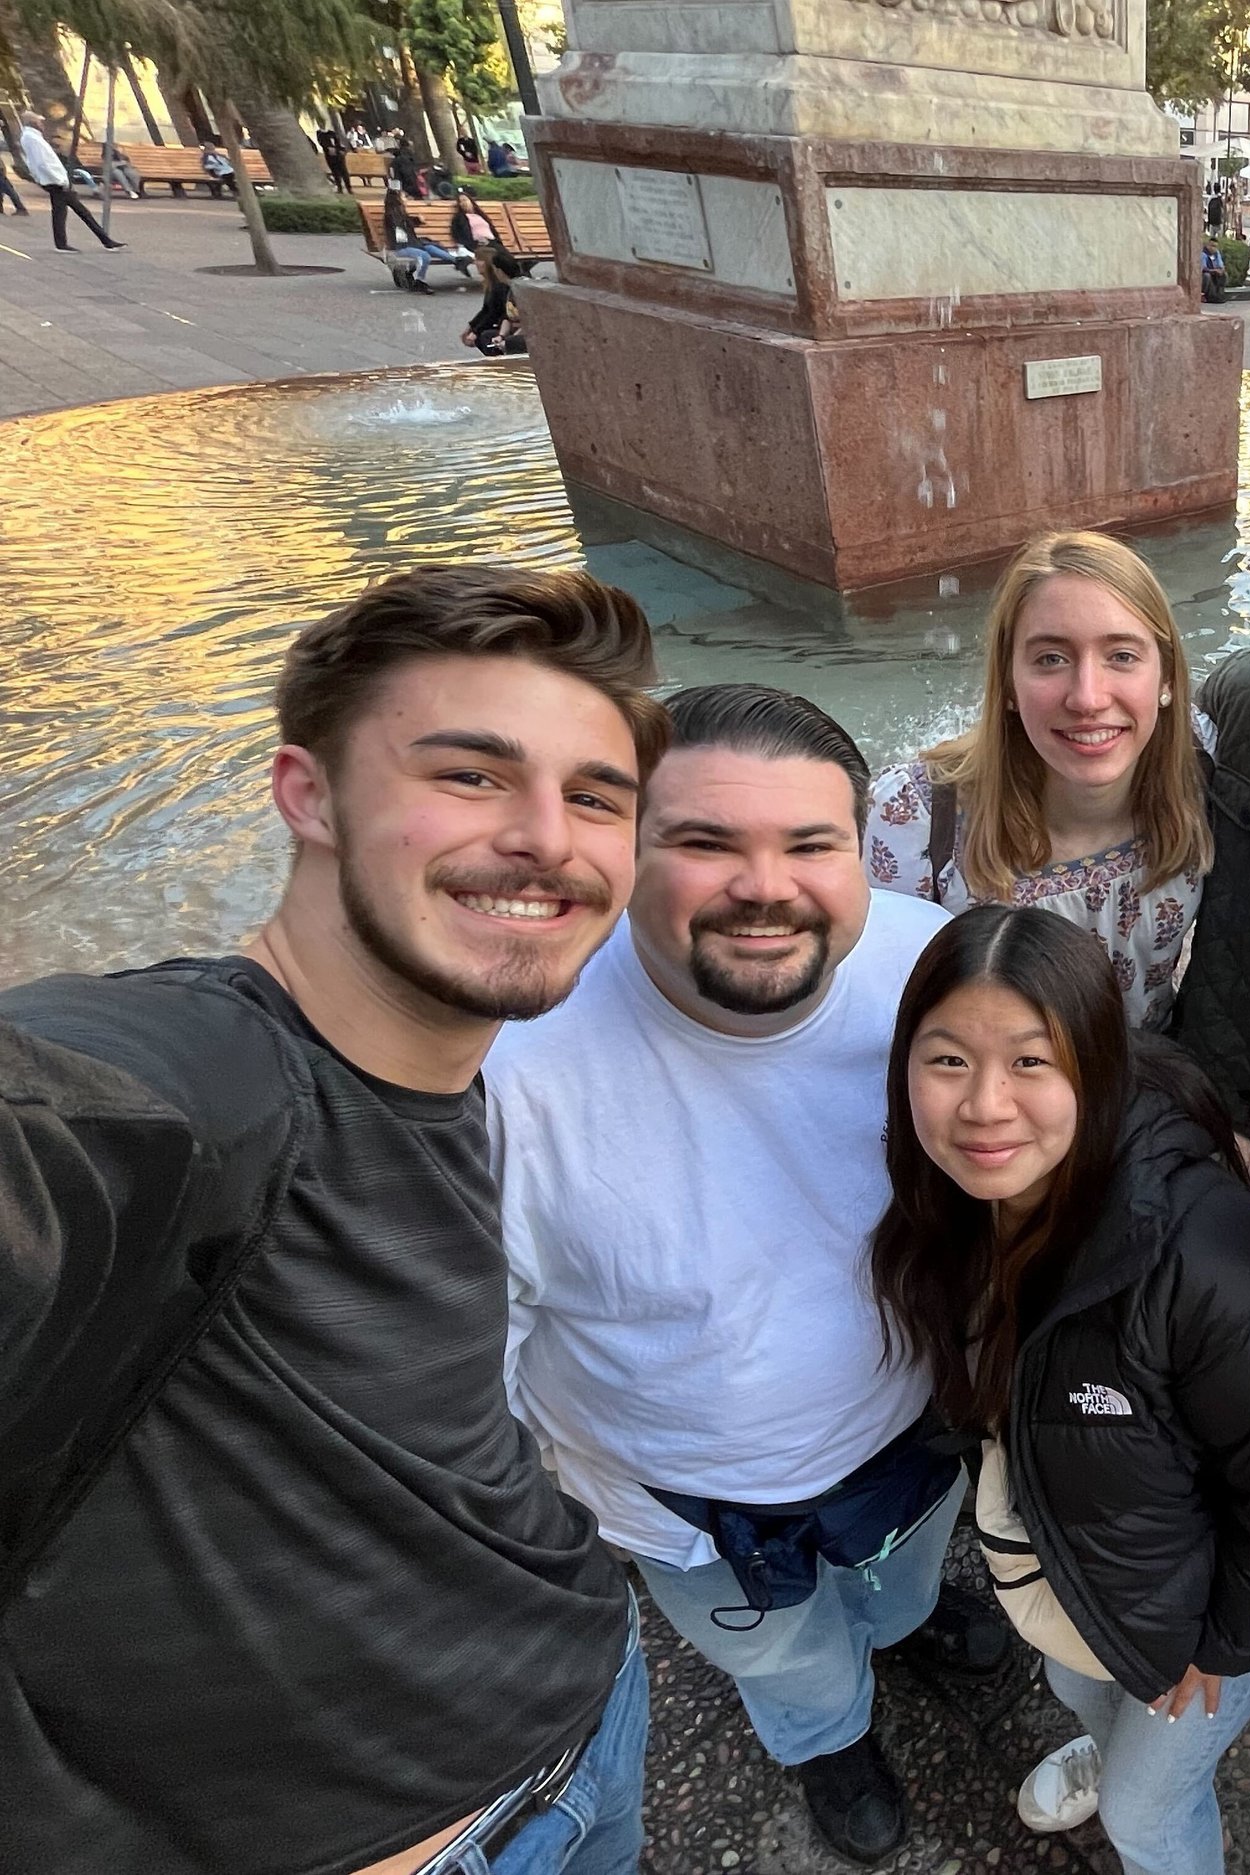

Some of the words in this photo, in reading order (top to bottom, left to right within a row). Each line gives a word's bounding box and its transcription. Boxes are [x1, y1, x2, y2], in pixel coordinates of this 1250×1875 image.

[1082, 1382, 1107, 1395] THE
[1068, 1392, 1109, 1404] NORTH
[1081, 1403, 1111, 1415] FACE
